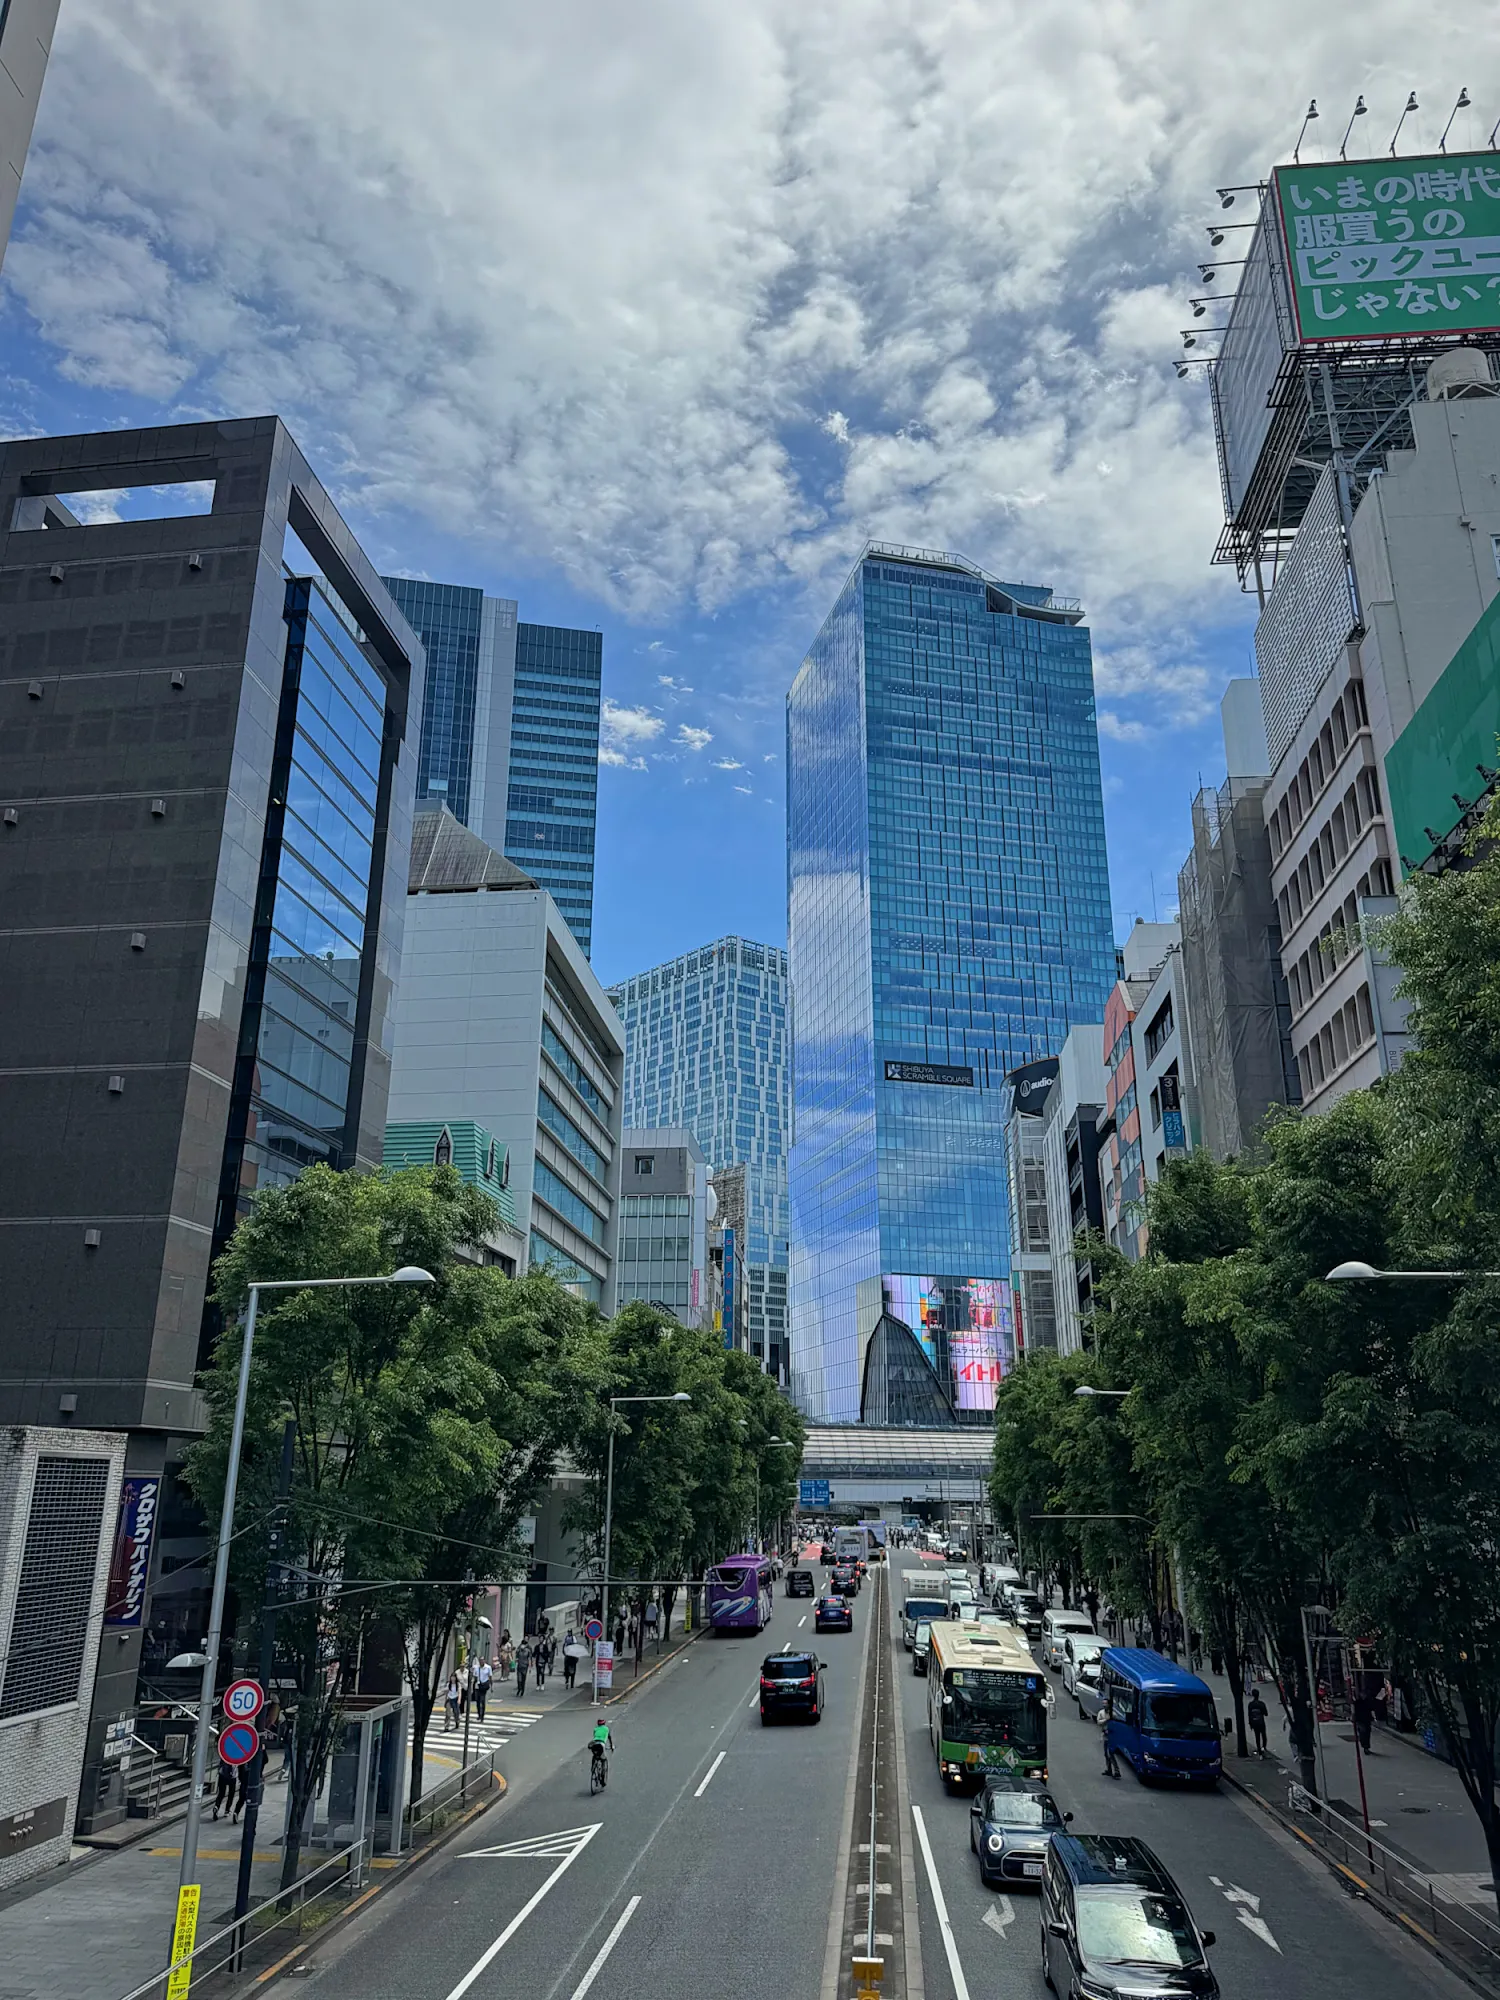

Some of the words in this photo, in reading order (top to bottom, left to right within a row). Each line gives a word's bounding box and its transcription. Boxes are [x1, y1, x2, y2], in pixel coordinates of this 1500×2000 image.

[1289, 166, 1500, 209] いまの時代
[1294, 208, 1466, 249] 服買うの
[902, 1064, 934, 1074] SHIBUYA
[902, 1072, 941, 1083] SCRAMBLE
[942, 1076, 972, 1085] SQUARE
[1165, 1116, 1174, 1145] クリニック
[121, 1482, 158, 1620] クロサワバイオリン
[232, 1691, 255, 1710] 50
